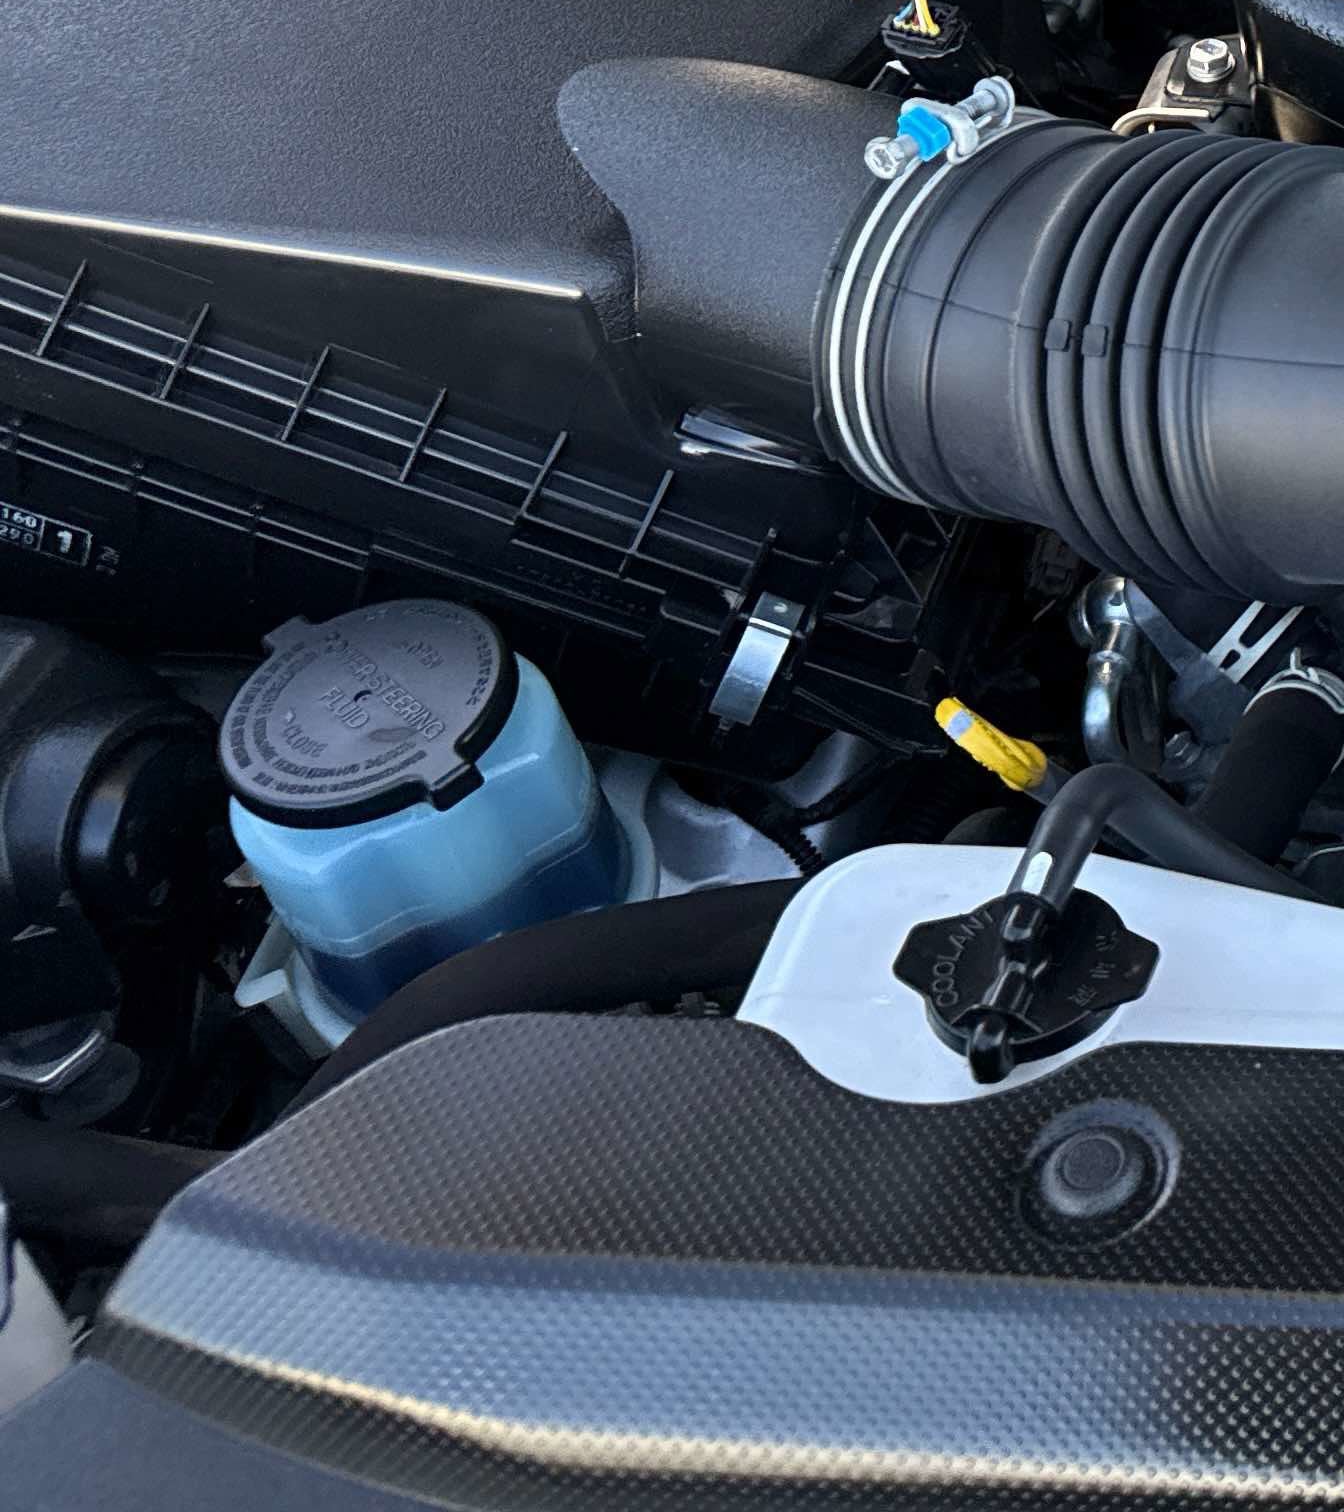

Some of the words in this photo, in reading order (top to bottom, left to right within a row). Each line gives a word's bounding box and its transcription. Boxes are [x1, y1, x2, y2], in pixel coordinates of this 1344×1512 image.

[56, 529, 73, 554] 1
[319, 686, 370, 730] FLUID
[368, 671, 446, 741] STEERING
[932, 909, 993, 1007] COOLANT
